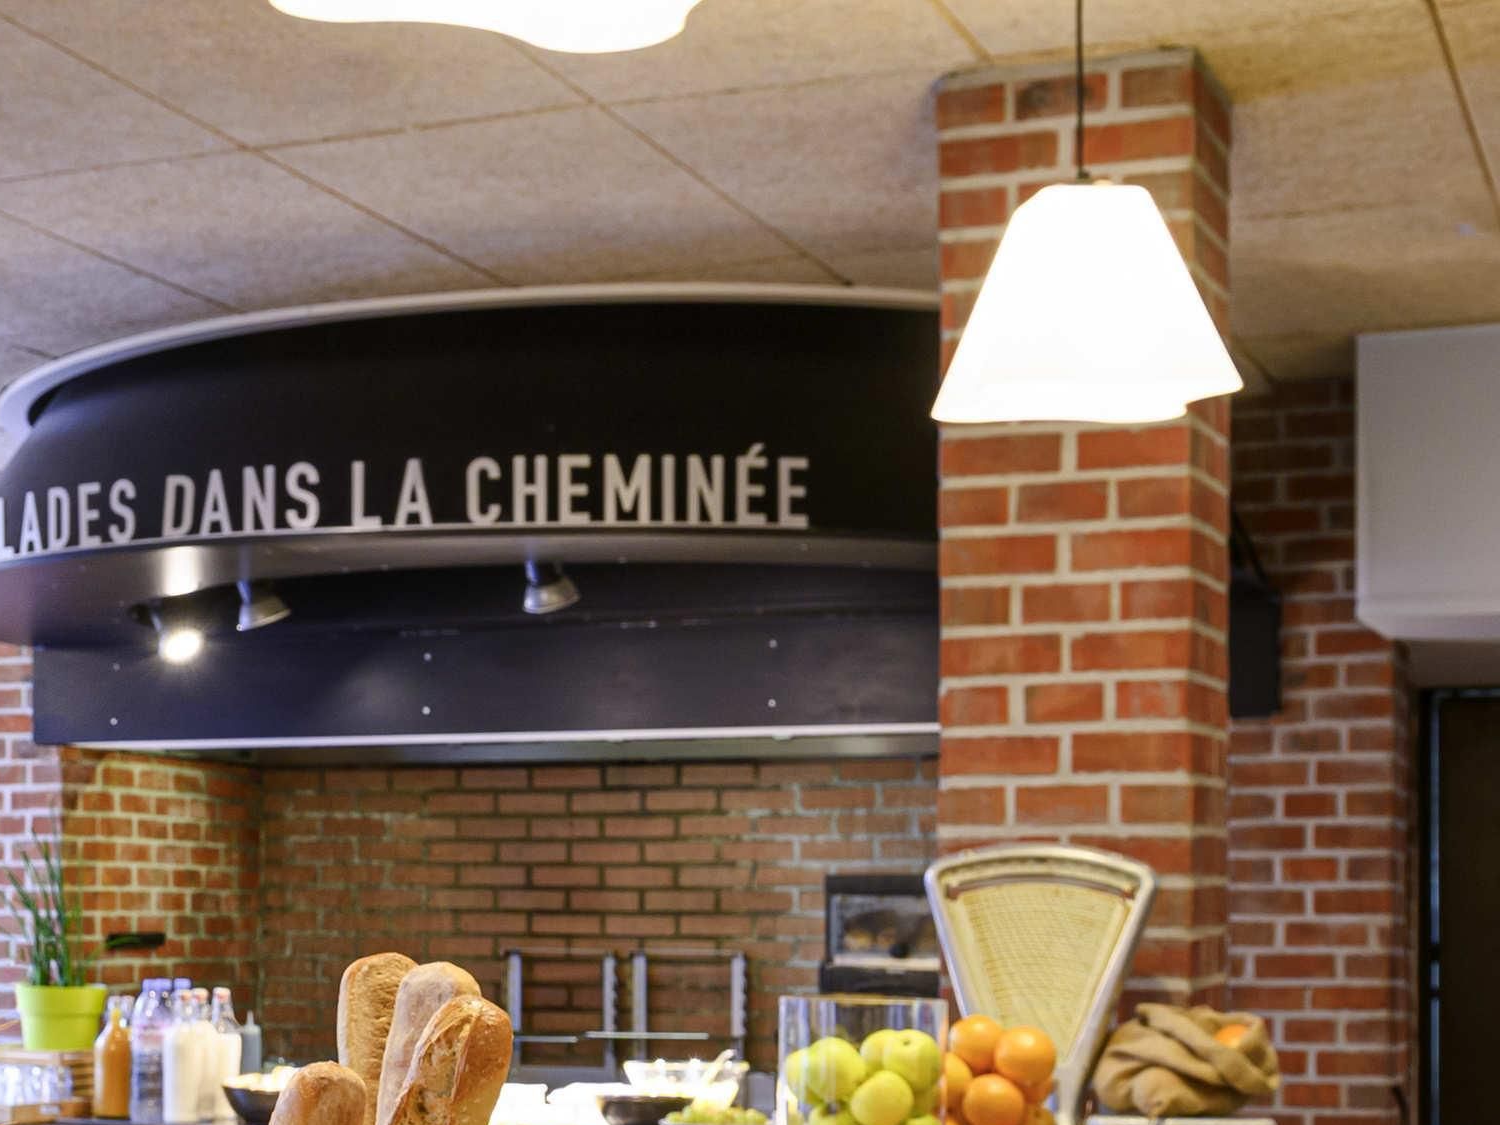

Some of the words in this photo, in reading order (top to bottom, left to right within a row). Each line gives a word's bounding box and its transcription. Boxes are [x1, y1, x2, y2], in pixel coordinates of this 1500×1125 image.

[162, 460, 321, 537] DANS
[350, 458, 435, 527] LA
[464, 443, 811, 526] CHEMINÉE
